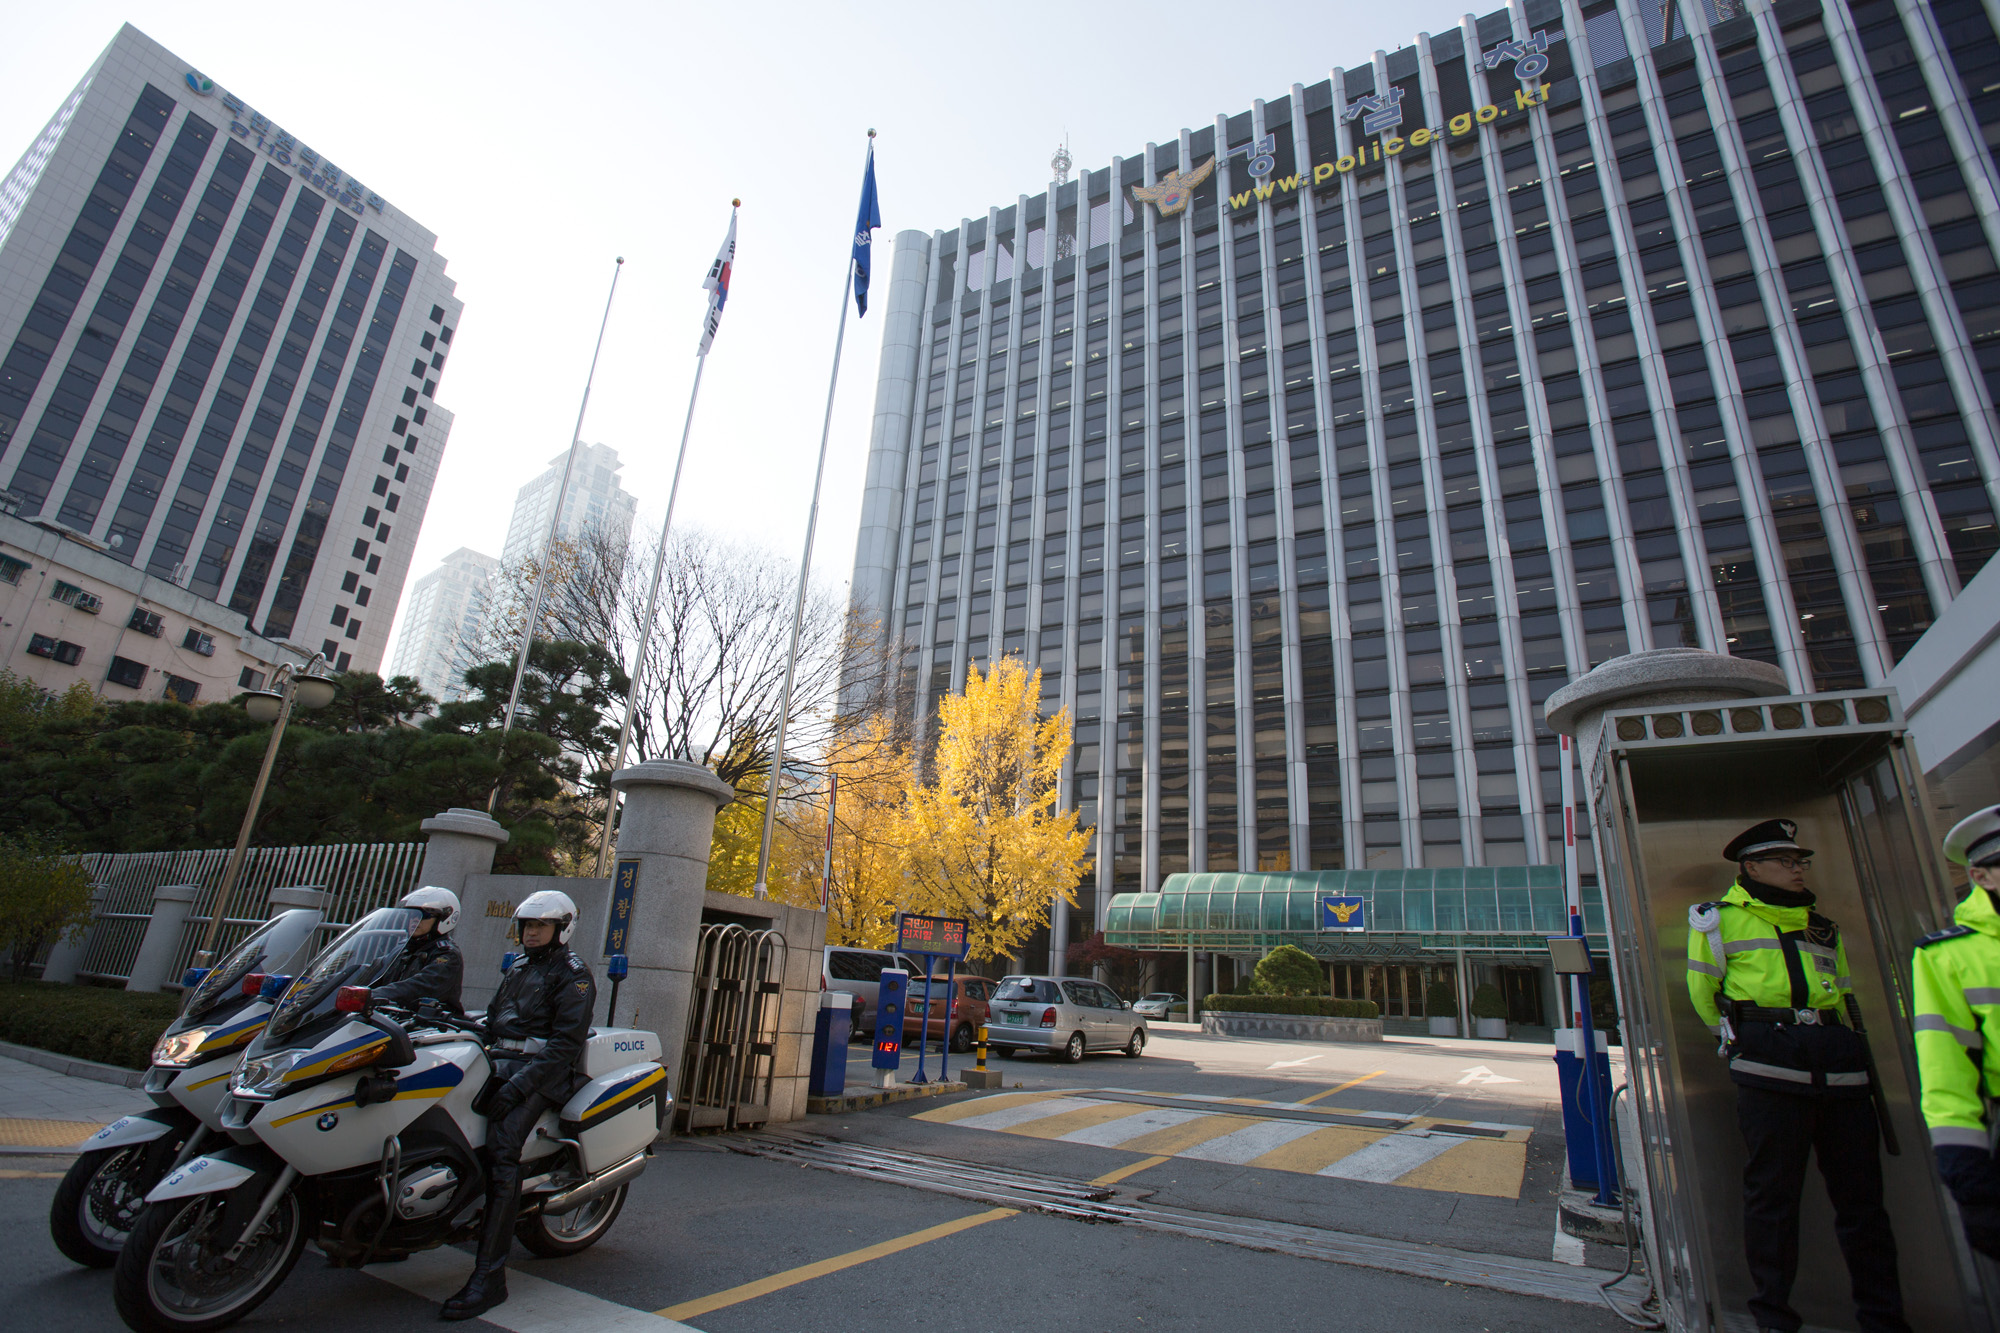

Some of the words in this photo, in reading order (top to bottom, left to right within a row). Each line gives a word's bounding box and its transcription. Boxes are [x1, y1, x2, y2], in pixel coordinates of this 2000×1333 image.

[1226, 29, 1549, 178] 경찰청
[1228, 82, 1551, 210] www.police.go.kr
[611, 868, 634, 949] 경찰청
[614, 1040, 645, 1053] POLICE
